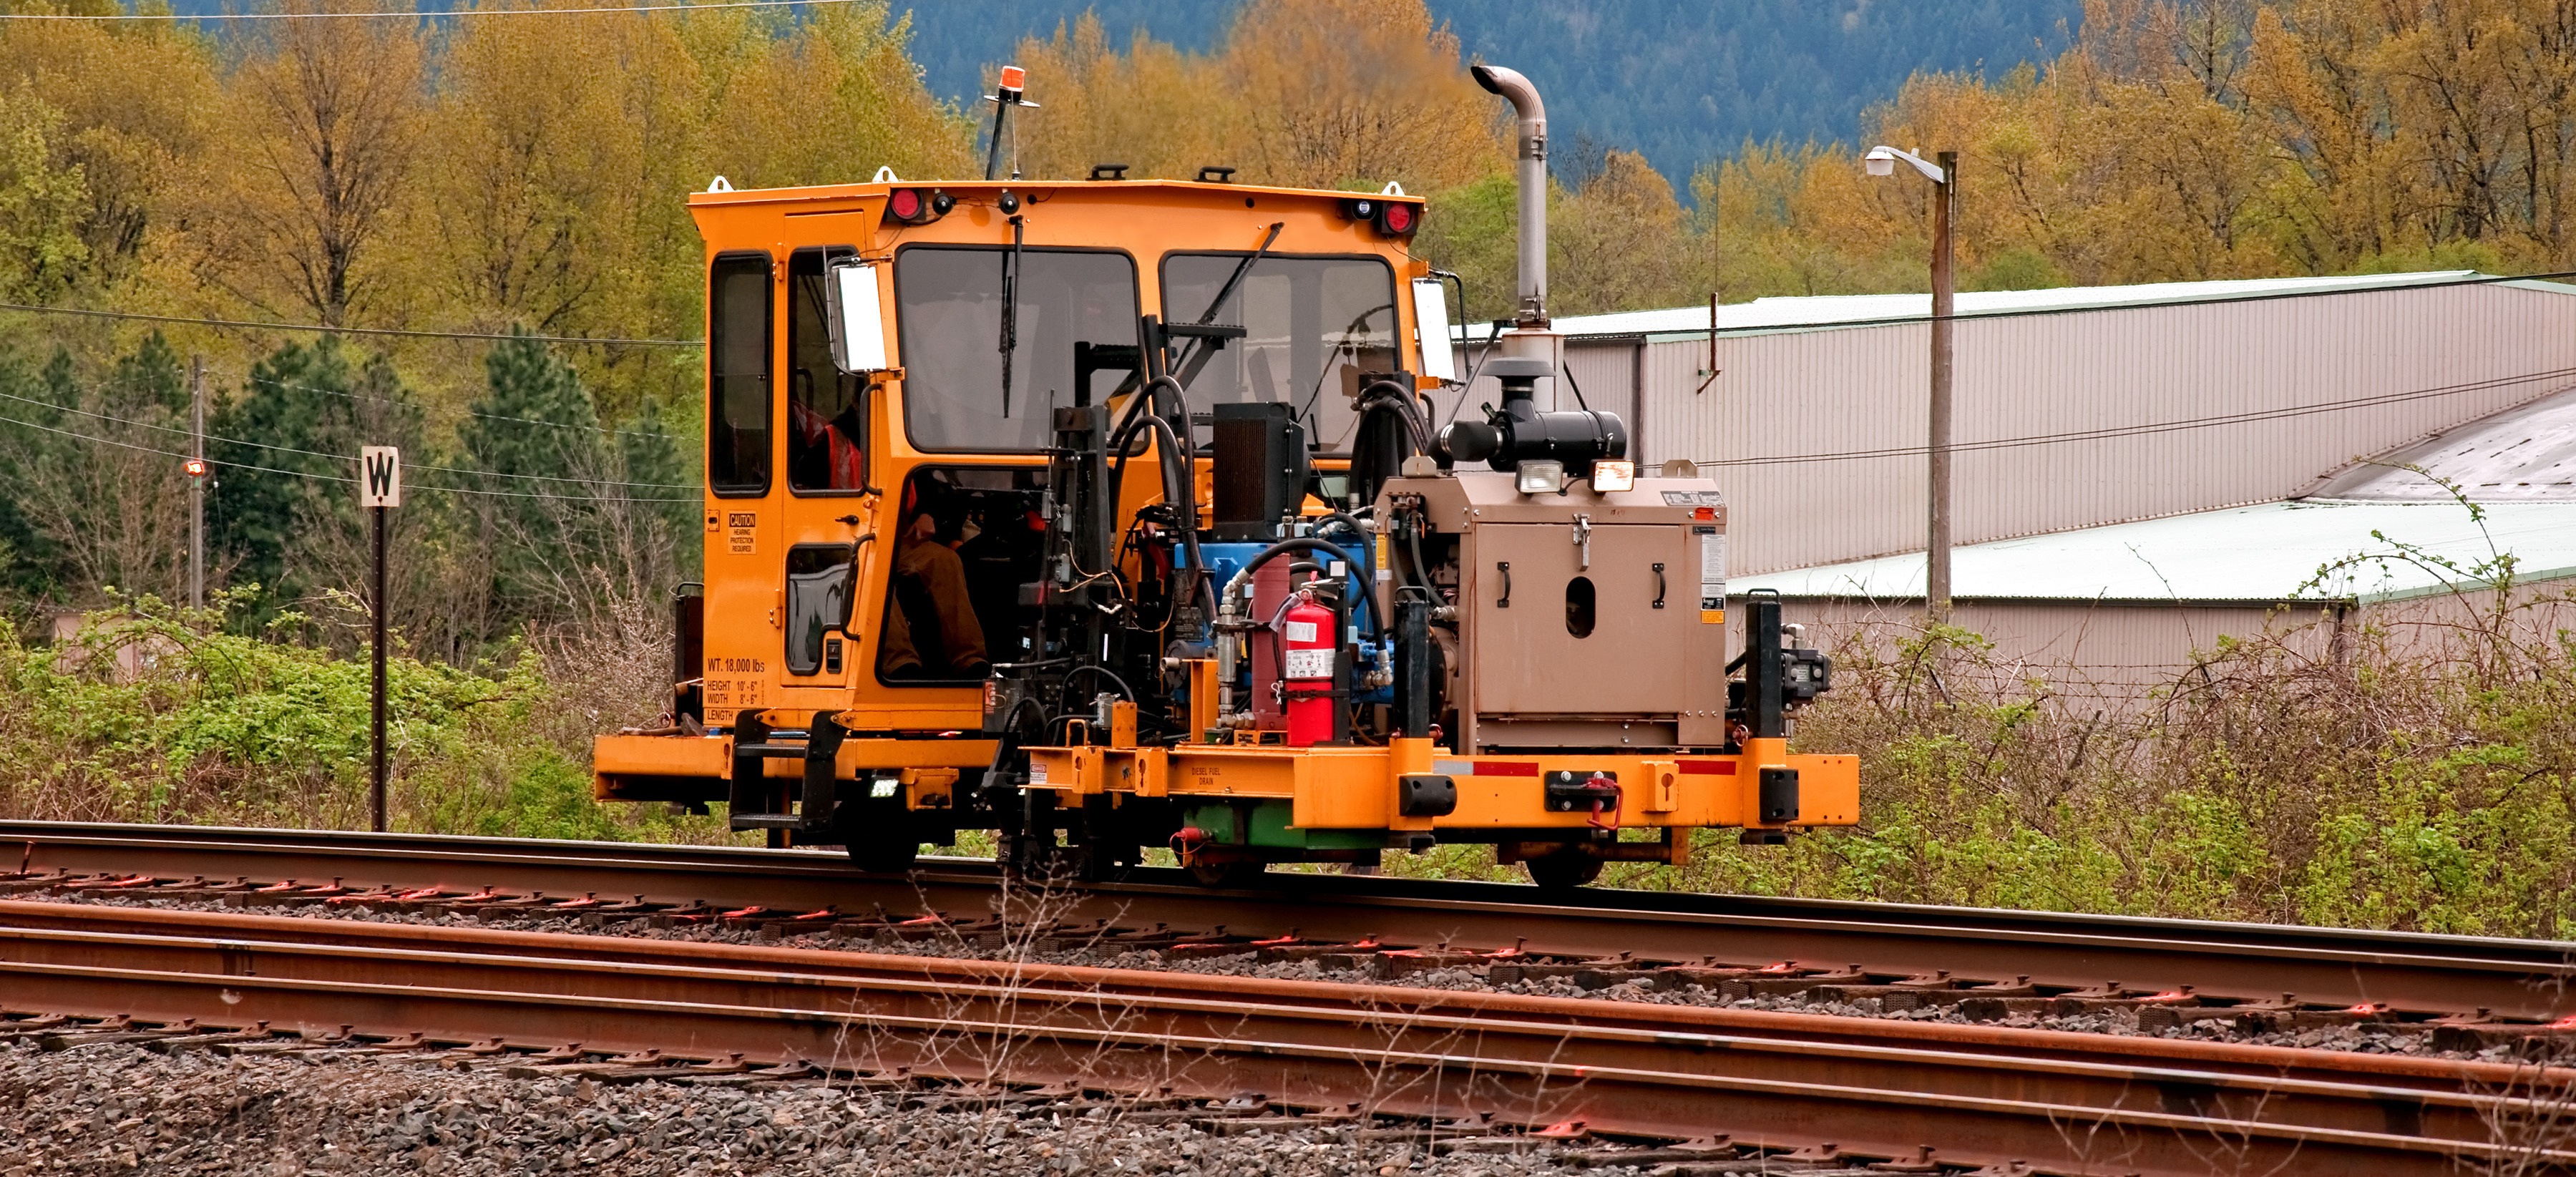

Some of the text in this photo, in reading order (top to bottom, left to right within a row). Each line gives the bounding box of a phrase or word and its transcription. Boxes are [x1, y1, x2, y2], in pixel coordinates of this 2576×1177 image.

[366, 456, 394, 496] W
[731, 514, 754, 526] CAUTION
[708, 658, 765, 674] WT. 18,000 lbs
[707, 680, 731, 691] HEIGHT
[737, 680, 746, 691] 10'
[707, 693, 728, 704] WIDTH
[707, 709, 733, 721] LENGTH
[1191, 767, 1221, 776] DIESEL FUEL
[1199, 777, 1214, 786] DRAIN
